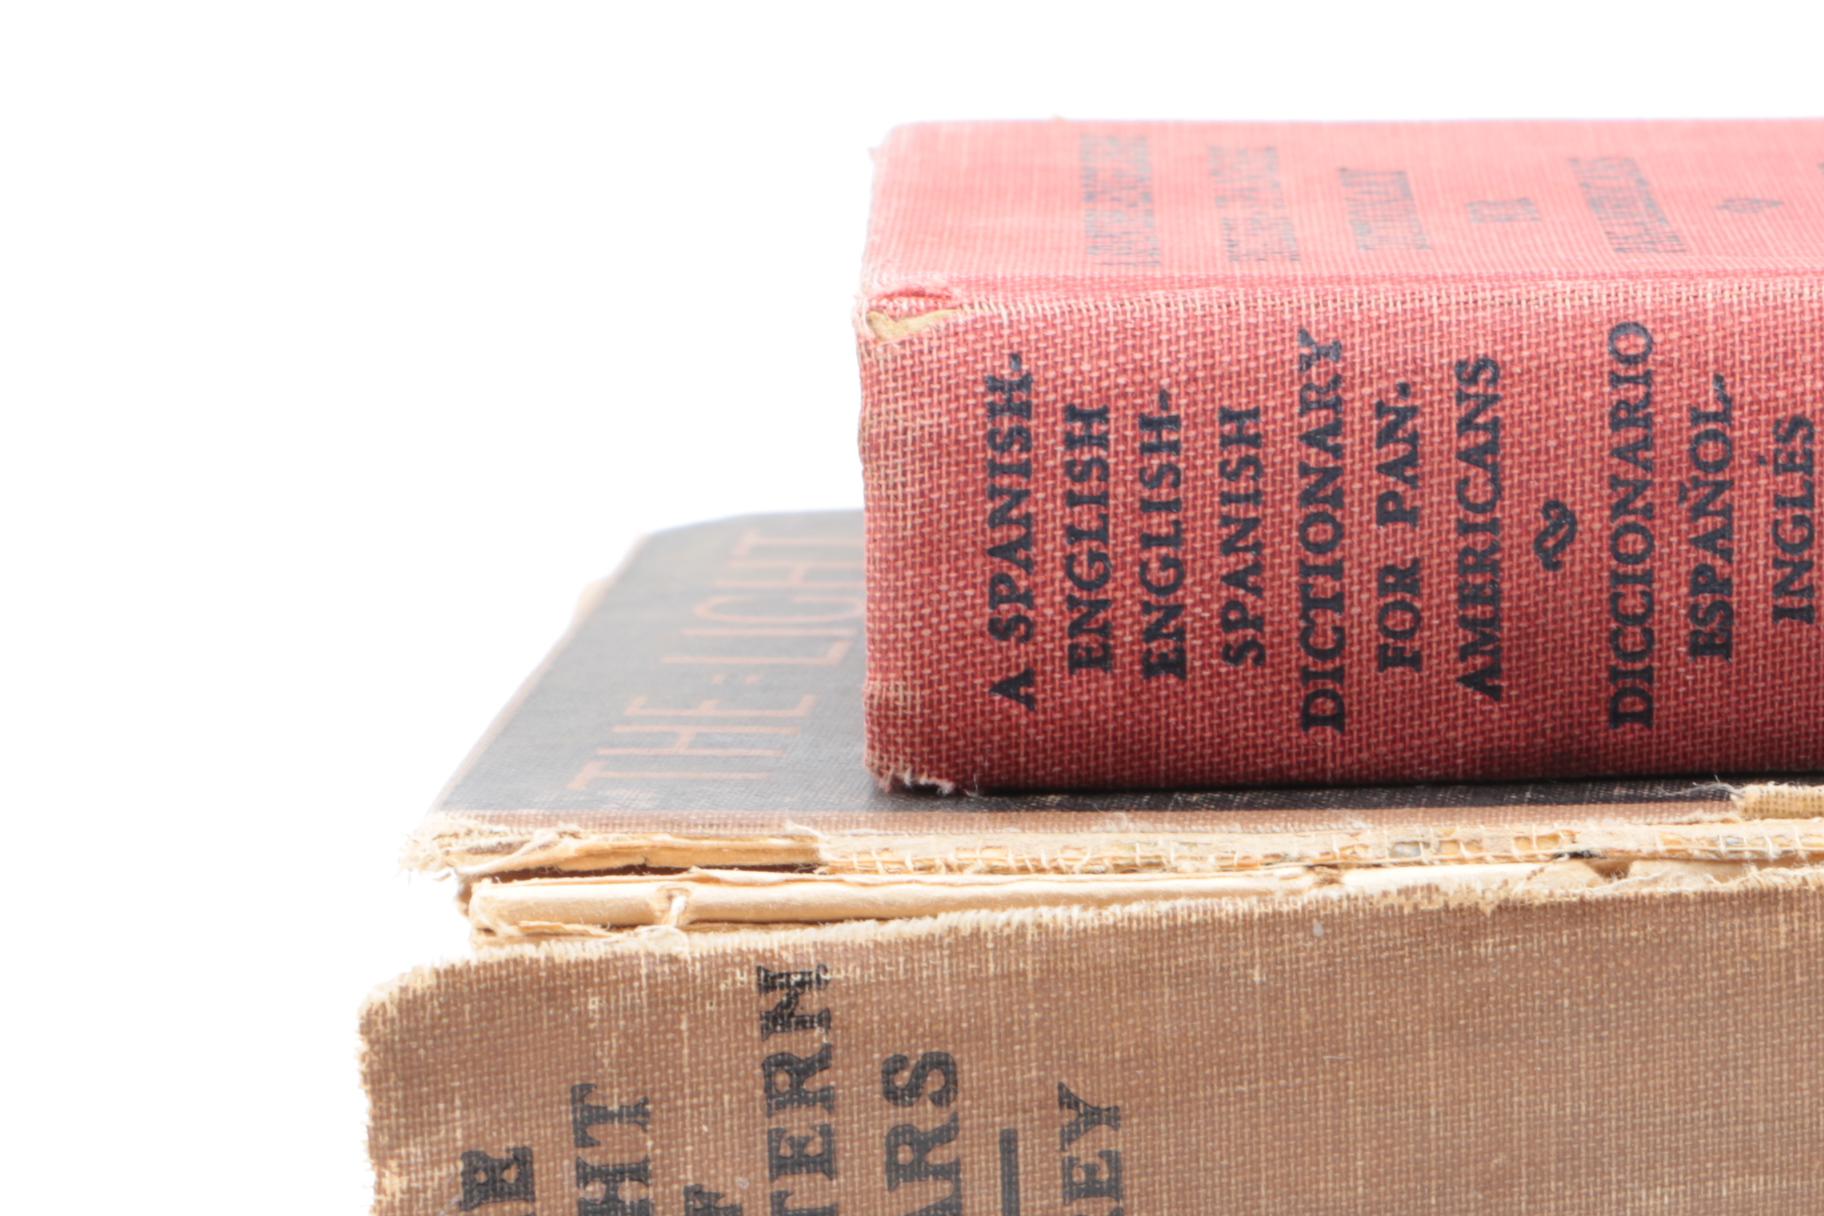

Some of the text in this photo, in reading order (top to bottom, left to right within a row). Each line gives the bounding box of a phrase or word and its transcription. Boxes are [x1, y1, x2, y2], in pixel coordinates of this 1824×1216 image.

[985, 353, 1036, 711] A SPANISH-
[1064, 404, 1112, 674] ENGLISH
[1139, 390, 1186, 681] ENGLISH-
[1218, 405, 1265, 666] SPANISH
[1298, 329, 1344, 734] DICTIONARY
[1376, 382, 1421, 673] FOR PAN-
[1456, 356, 1502, 702] AMERICANS
[1608, 320, 1655, 730] DICCIONARIO
[1678, 373, 1734, 659] ESPAÑOL-
[1757, 415, 1816, 626] INGLÉS
[566, 694, 816, 791] THE
